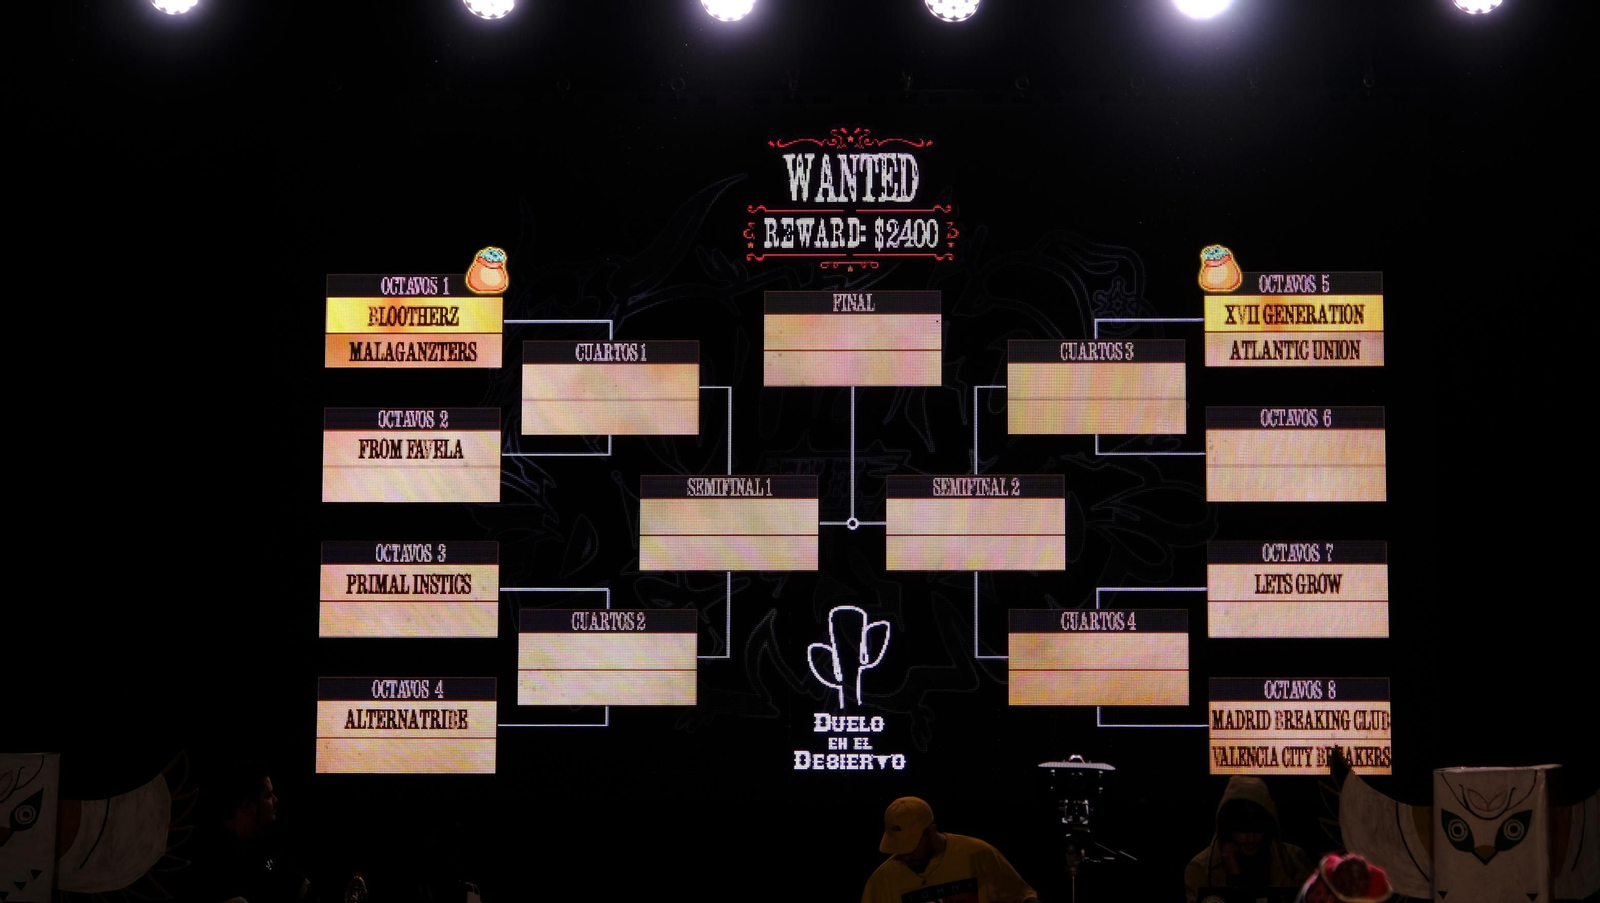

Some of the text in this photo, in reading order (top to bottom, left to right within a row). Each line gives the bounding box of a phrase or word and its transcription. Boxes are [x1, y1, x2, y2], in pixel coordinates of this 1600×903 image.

[782, 153, 920, 203] WANTED
[764, 216, 939, 251] REWARD: $2400
[380, 277, 451, 296] OCTAVOS 1
[1259, 275, 1330, 293] OCTAVOS 5
[832, 294, 876, 312] FINAL
[368, 306, 460, 327] BLOOTHERZ
[1224, 304, 1365, 325] XVII GENERATION
[349, 341, 478, 362] MALAGANZTERS
[575, 343, 648, 362] CUARTOS 1
[1060, 342, 1134, 361] CUARTOS 3
[1230, 340, 1361, 361] ATLANTIC UNION
[378, 410, 449, 428] OCTAVOS 2
[1260, 409, 1332, 427] OCTAVOS 6
[358, 438, 464, 459] FROM FAVELA
[687, 478, 773, 497] SEMIFINAL 1
[933, 478, 1020, 497] SEMIFINAL 2
[375, 544, 446, 562] OCTAVOS 3
[1262, 544, 1334, 562] OCTAVOS 7
[346, 573, 472, 595] PRIMAL INSTICS
[1255, 573, 1342, 594] LETS GROW
[571, 612, 646, 631] CUARTOS 2
[1061, 612, 1136, 631] CUARTOS 4
[371, 680, 444, 699] OCTAVOS 4
[1264, 680, 1336, 699] OCTAVOS 8
[344, 709, 468, 730] ALTERNATRIBE
[814, 713, 884, 733] DUELO
[1212, 710, 1390, 730] MADRID BREAKING CLUB
[828, 738, 873, 750] EN EL
[1212, 746, 1391, 767] VALENCIA CITY BRAKERS
[906, 882, 974, 903] TOMMY
